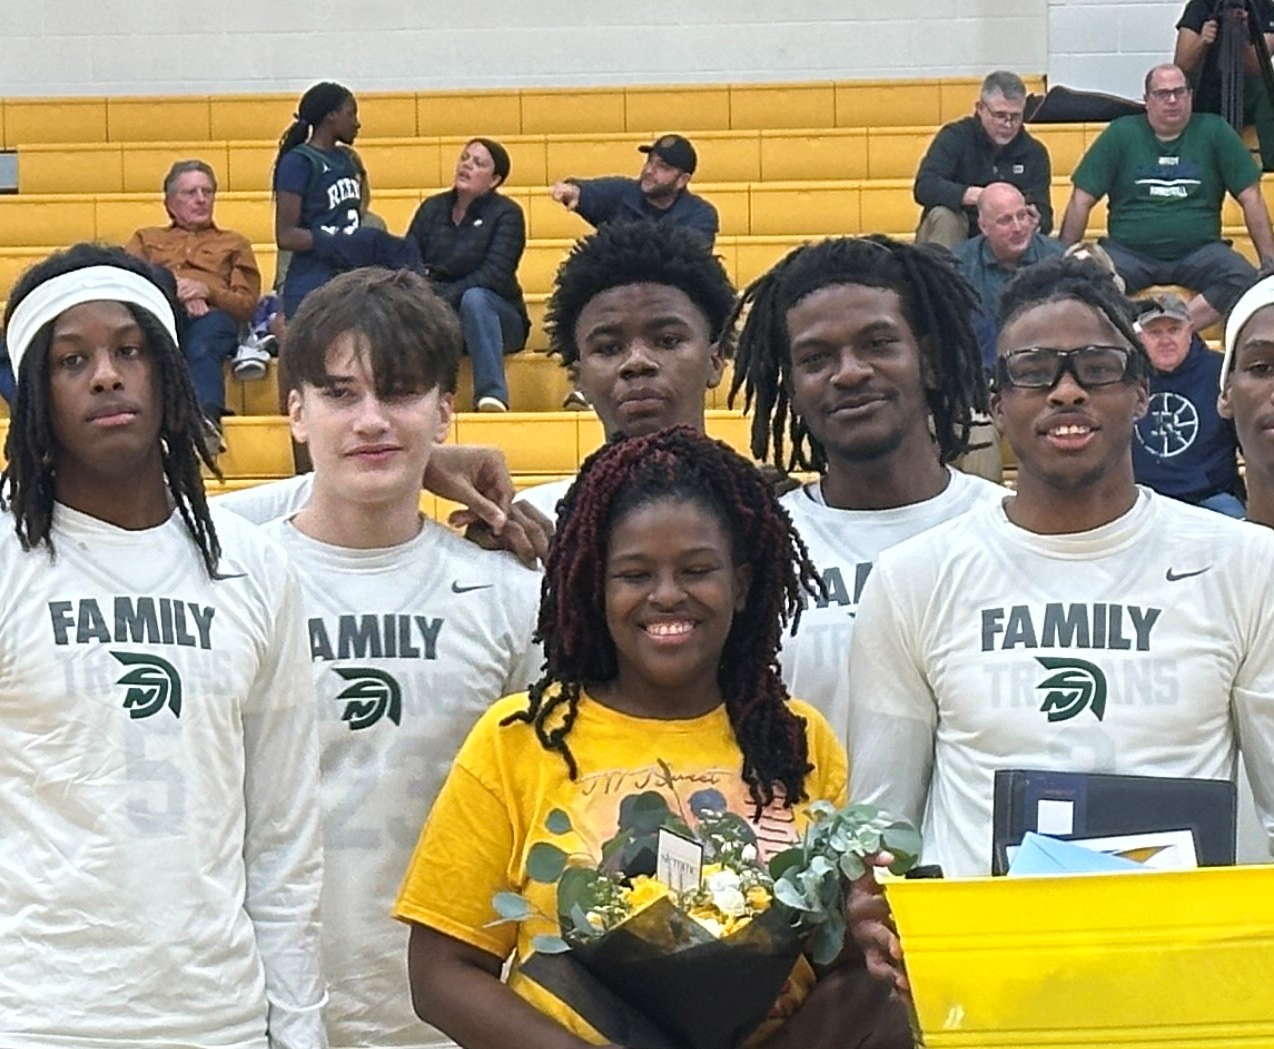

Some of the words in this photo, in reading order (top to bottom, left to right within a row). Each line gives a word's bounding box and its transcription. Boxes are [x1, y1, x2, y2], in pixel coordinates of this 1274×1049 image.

[48, 596, 215, 650] FAMILY
[308, 614, 444, 662] AMILY
[981, 602, 1162, 651] FAMILY
